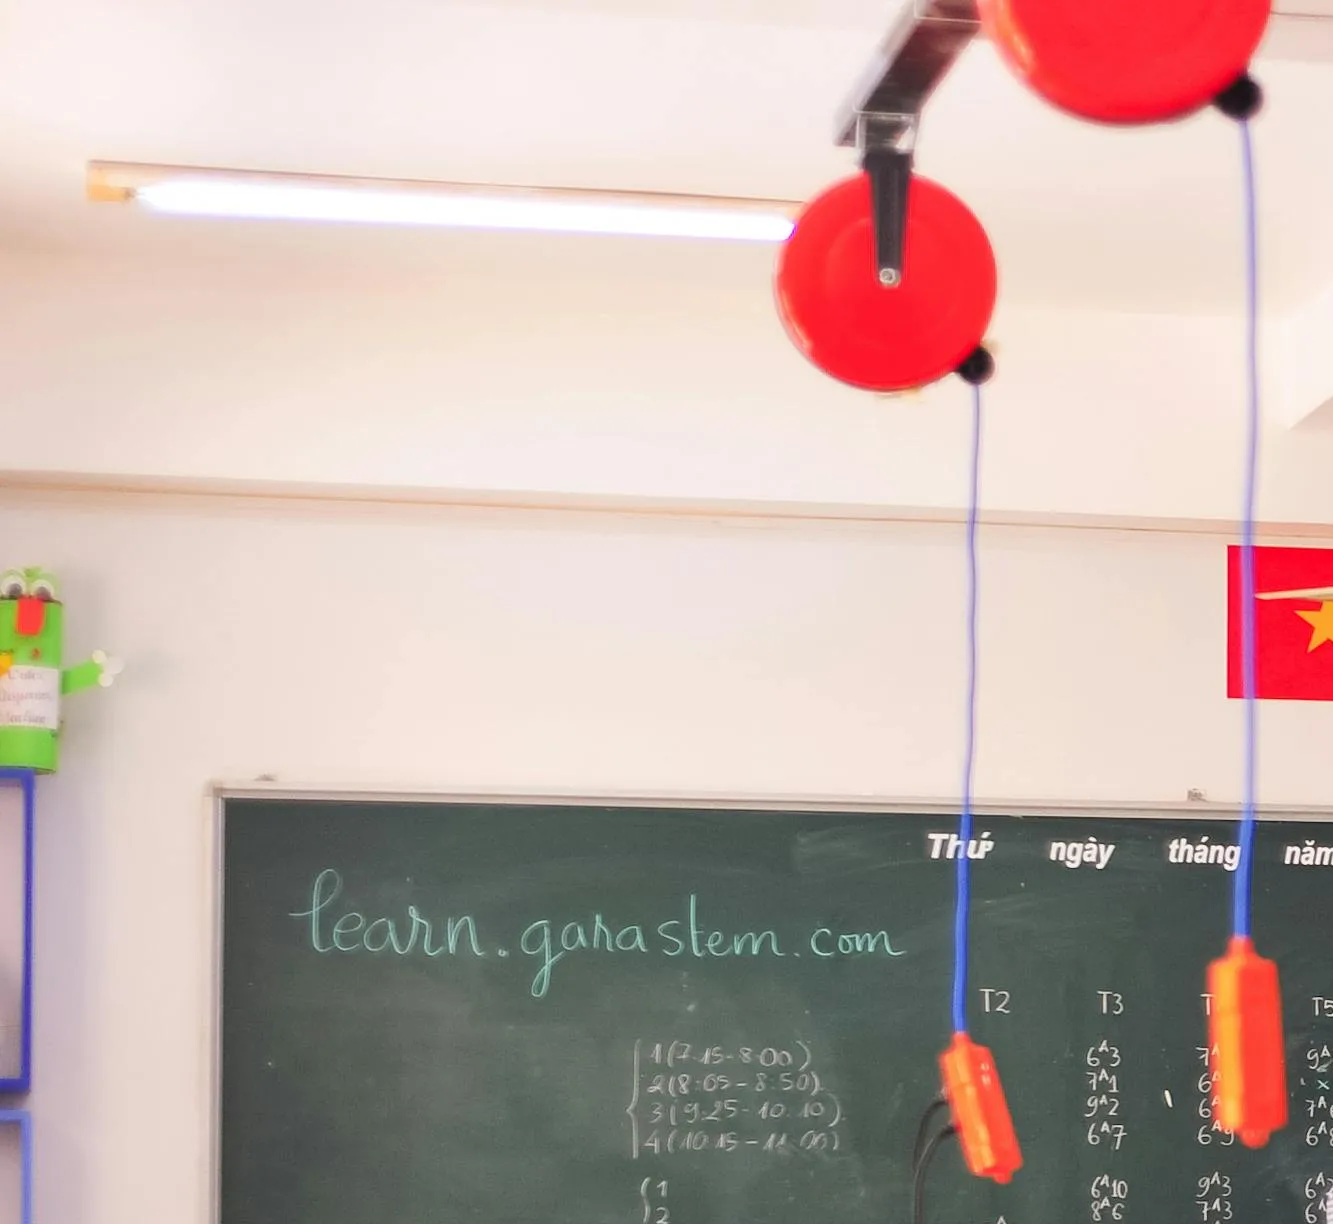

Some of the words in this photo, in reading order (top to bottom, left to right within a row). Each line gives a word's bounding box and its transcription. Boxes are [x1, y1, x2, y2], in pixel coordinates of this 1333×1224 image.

[1049, 833, 1116, 871] ngày
[1168, 834, 1242, 872] tháng
[979, 988, 1012, 1014] T2
[1096, 990, 1125, 1015] T3
[655, 1180, 669, 1197] 1
